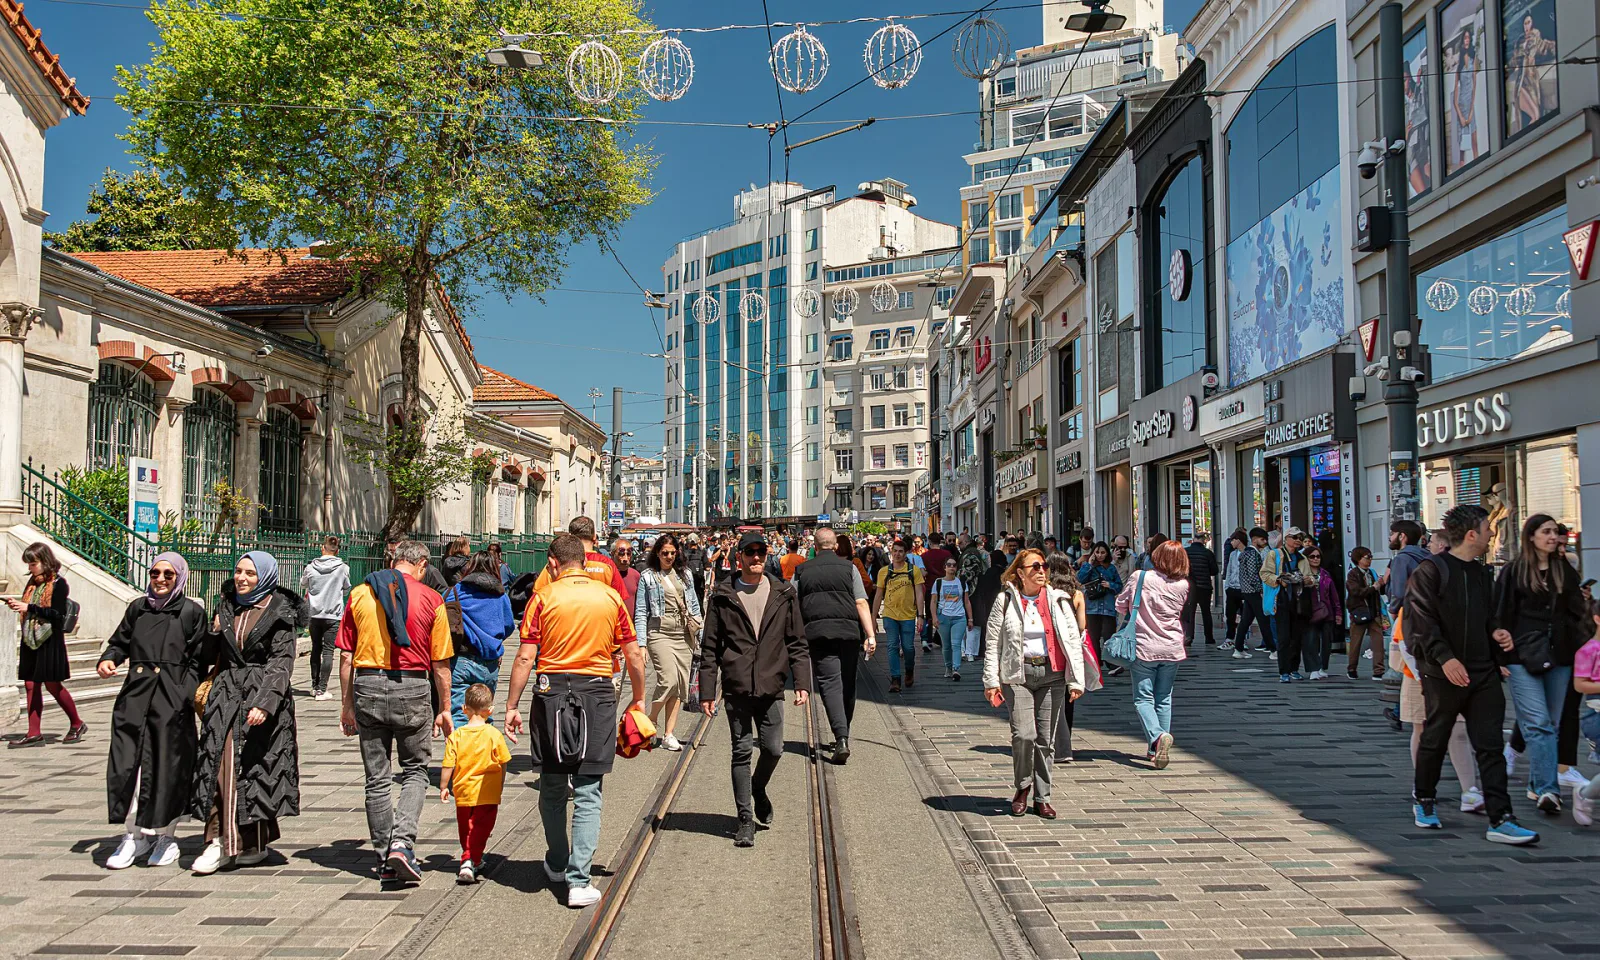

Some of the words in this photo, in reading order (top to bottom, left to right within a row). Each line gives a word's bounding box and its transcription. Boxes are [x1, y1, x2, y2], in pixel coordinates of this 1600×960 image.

[1568, 226, 1591, 246] GUESS
[1132, 410, 1173, 446] SuperStep
[1264, 422, 1297, 447] CHANGE
[1298, 412, 1329, 438] OFFICE
[1417, 392, 1510, 448] GUESS
[1343, 452, 1351, 533] WECHSEL
